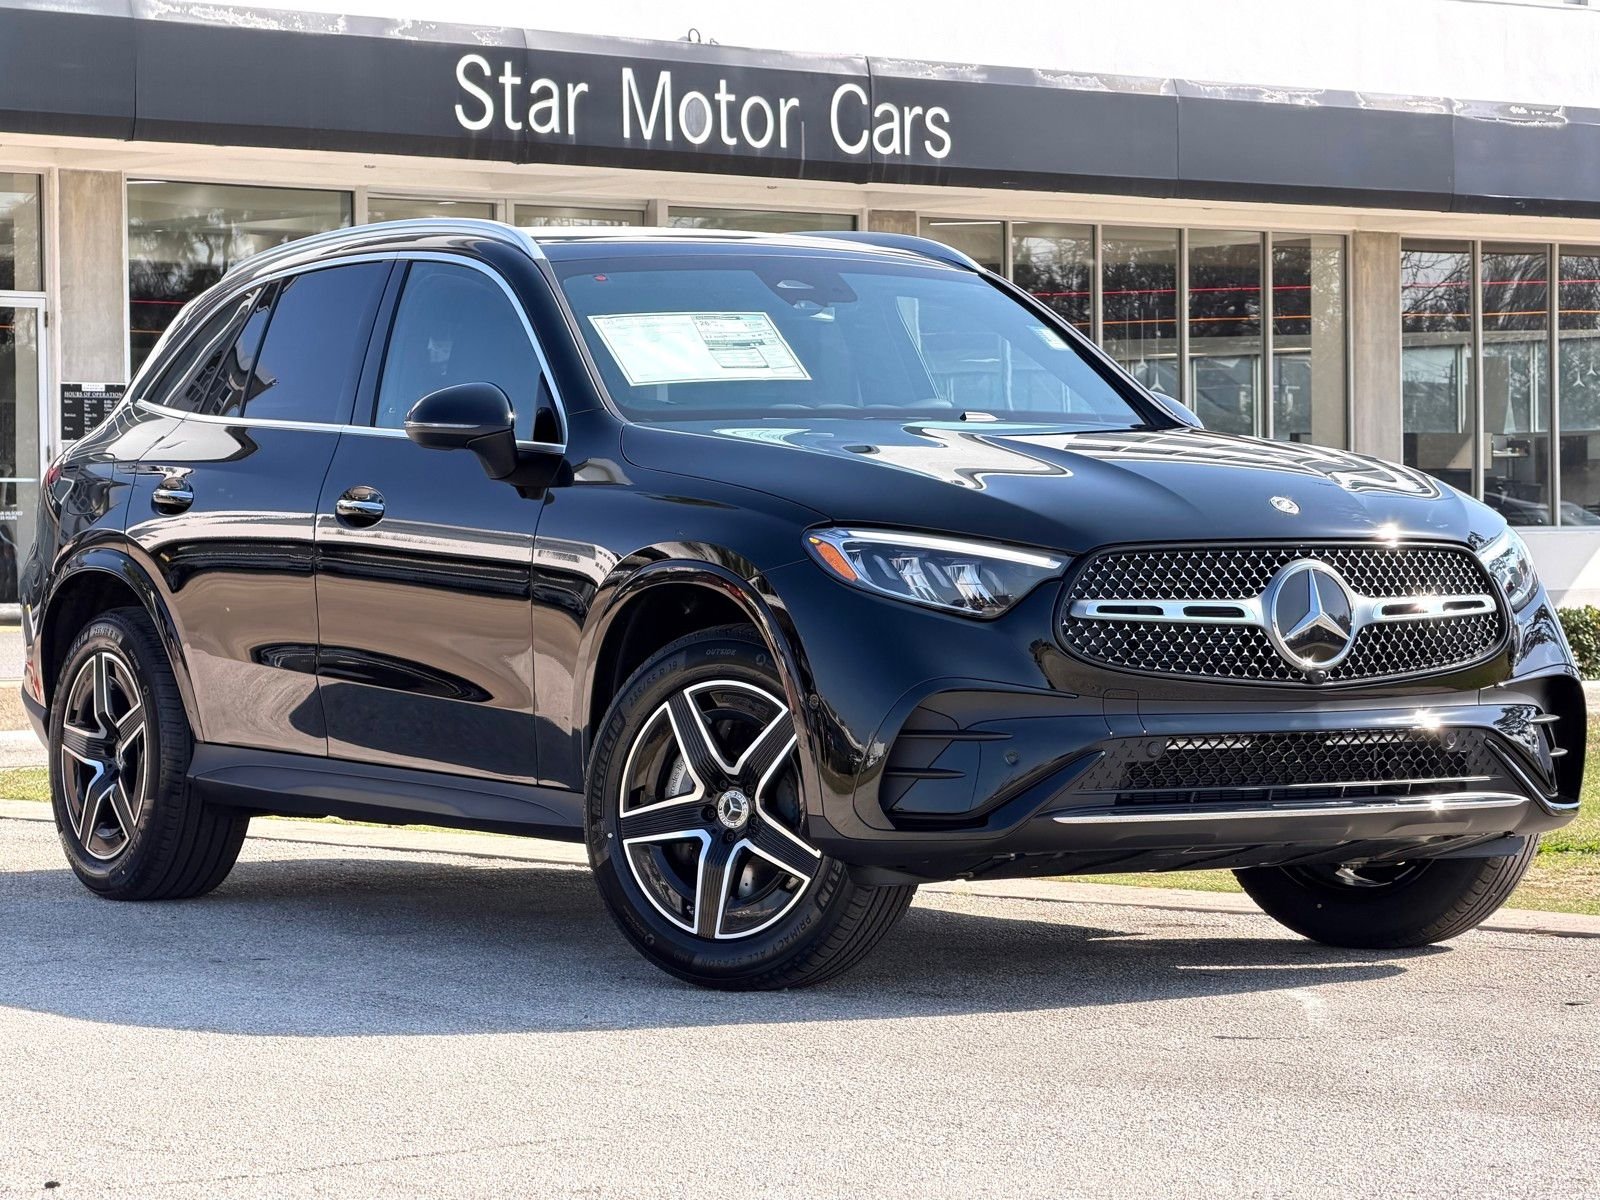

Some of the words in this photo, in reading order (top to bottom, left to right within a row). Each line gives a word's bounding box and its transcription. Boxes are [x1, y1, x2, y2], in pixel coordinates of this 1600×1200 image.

[455, 54, 588, 135] Star
[622, 67, 799, 149] Motor
[830, 83, 952, 159] Cars
[704, 647, 738, 656] OUTSIDE
[591, 711, 625, 816] MICHELIN
[817, 858, 843, 909] ELIN
[771, 914, 812, 954] PRIMACY
